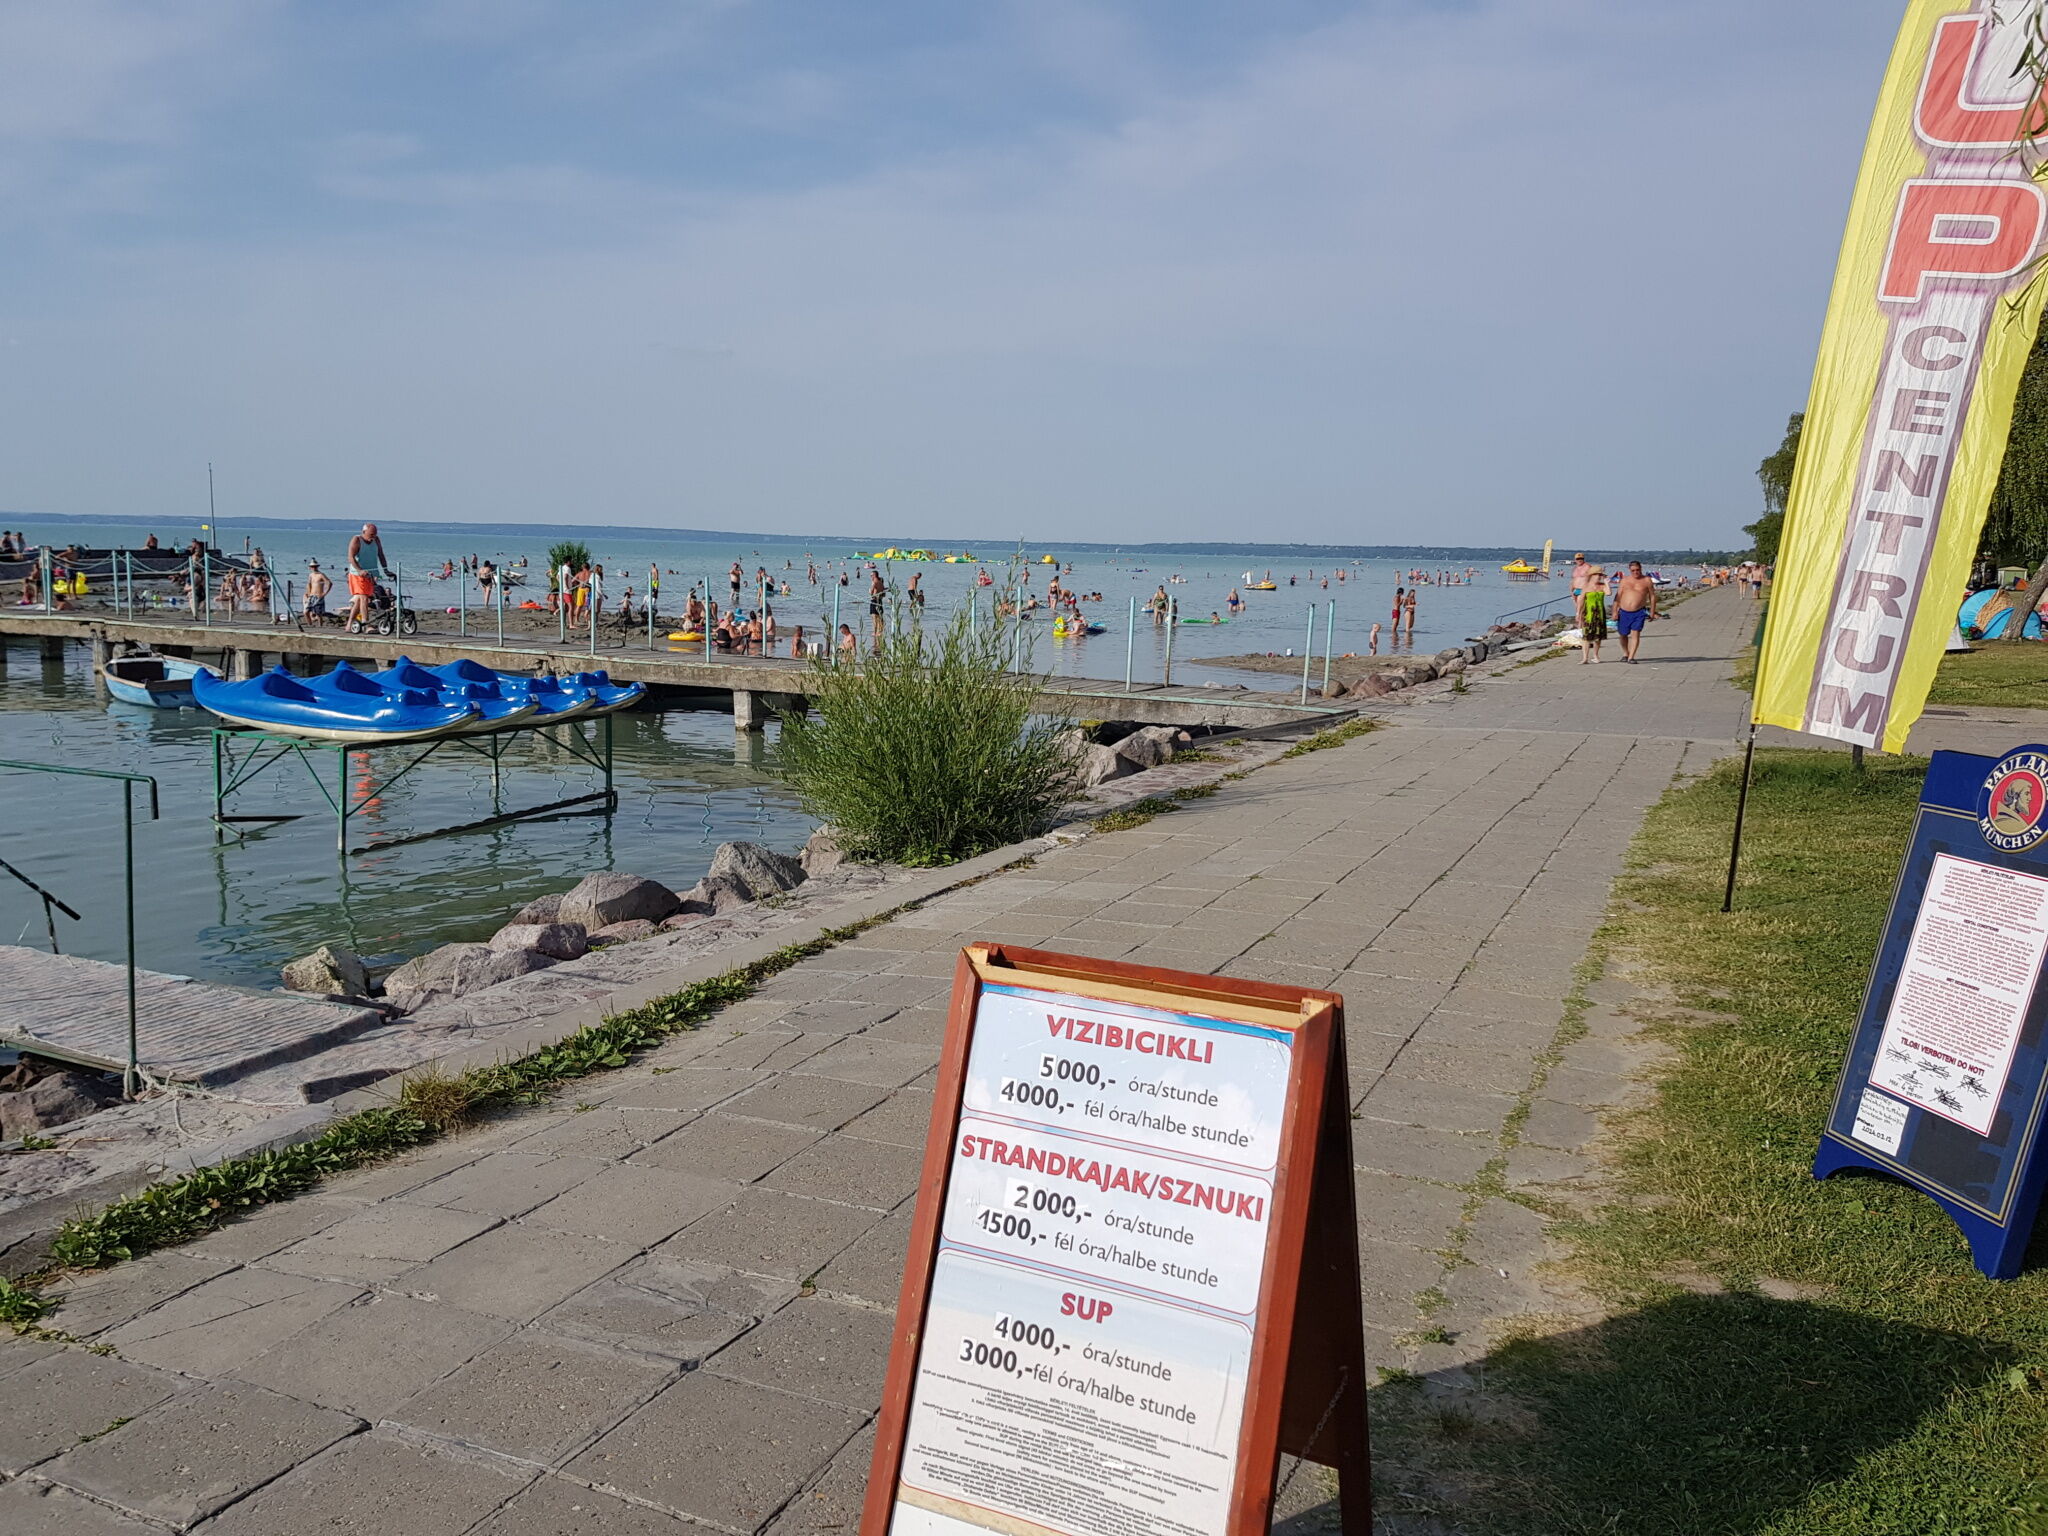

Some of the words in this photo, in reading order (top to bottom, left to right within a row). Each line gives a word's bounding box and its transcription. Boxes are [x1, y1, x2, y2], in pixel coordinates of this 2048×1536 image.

[1815, 325, 1967, 735] CENTRUM
[1984, 755, 2048, 801] PAULAN
[1980, 816, 2043, 848] MÜNCHEN
[1046, 1014, 1214, 1064] VIZIBICIKLI
[1921, 1045, 1956, 1065] VERBOTEN!
[1957, 1060, 1968, 1069] DO
[1968, 1064, 1985, 1077] NOT!
[1128, 1076, 1218, 1107] óra/stunde
[1084, 1100, 1104, 1118] fél
[1108, 1105, 1187, 1135] óra/halbe
[1191, 1125, 1249, 1148] stunde
[960, 1134, 1265, 1222] STRANDKAJAK/SZNUKI
[1104, 1210, 1195, 1245] óra/stunde
[1054, 1232, 1073, 1252] fél
[1079, 1238, 1157, 1272] óra/halbe
[1161, 1261, 1219, 1288] stunde
[1060, 1292, 1113, 1323] SUP
[1082, 1342, 1172, 1381] óra/stunde
[1033, 1362, 1052, 1385] fél
[1057, 1371, 1135, 1407] óra/halbe
[1139, 1395, 1197, 1425] stunde
